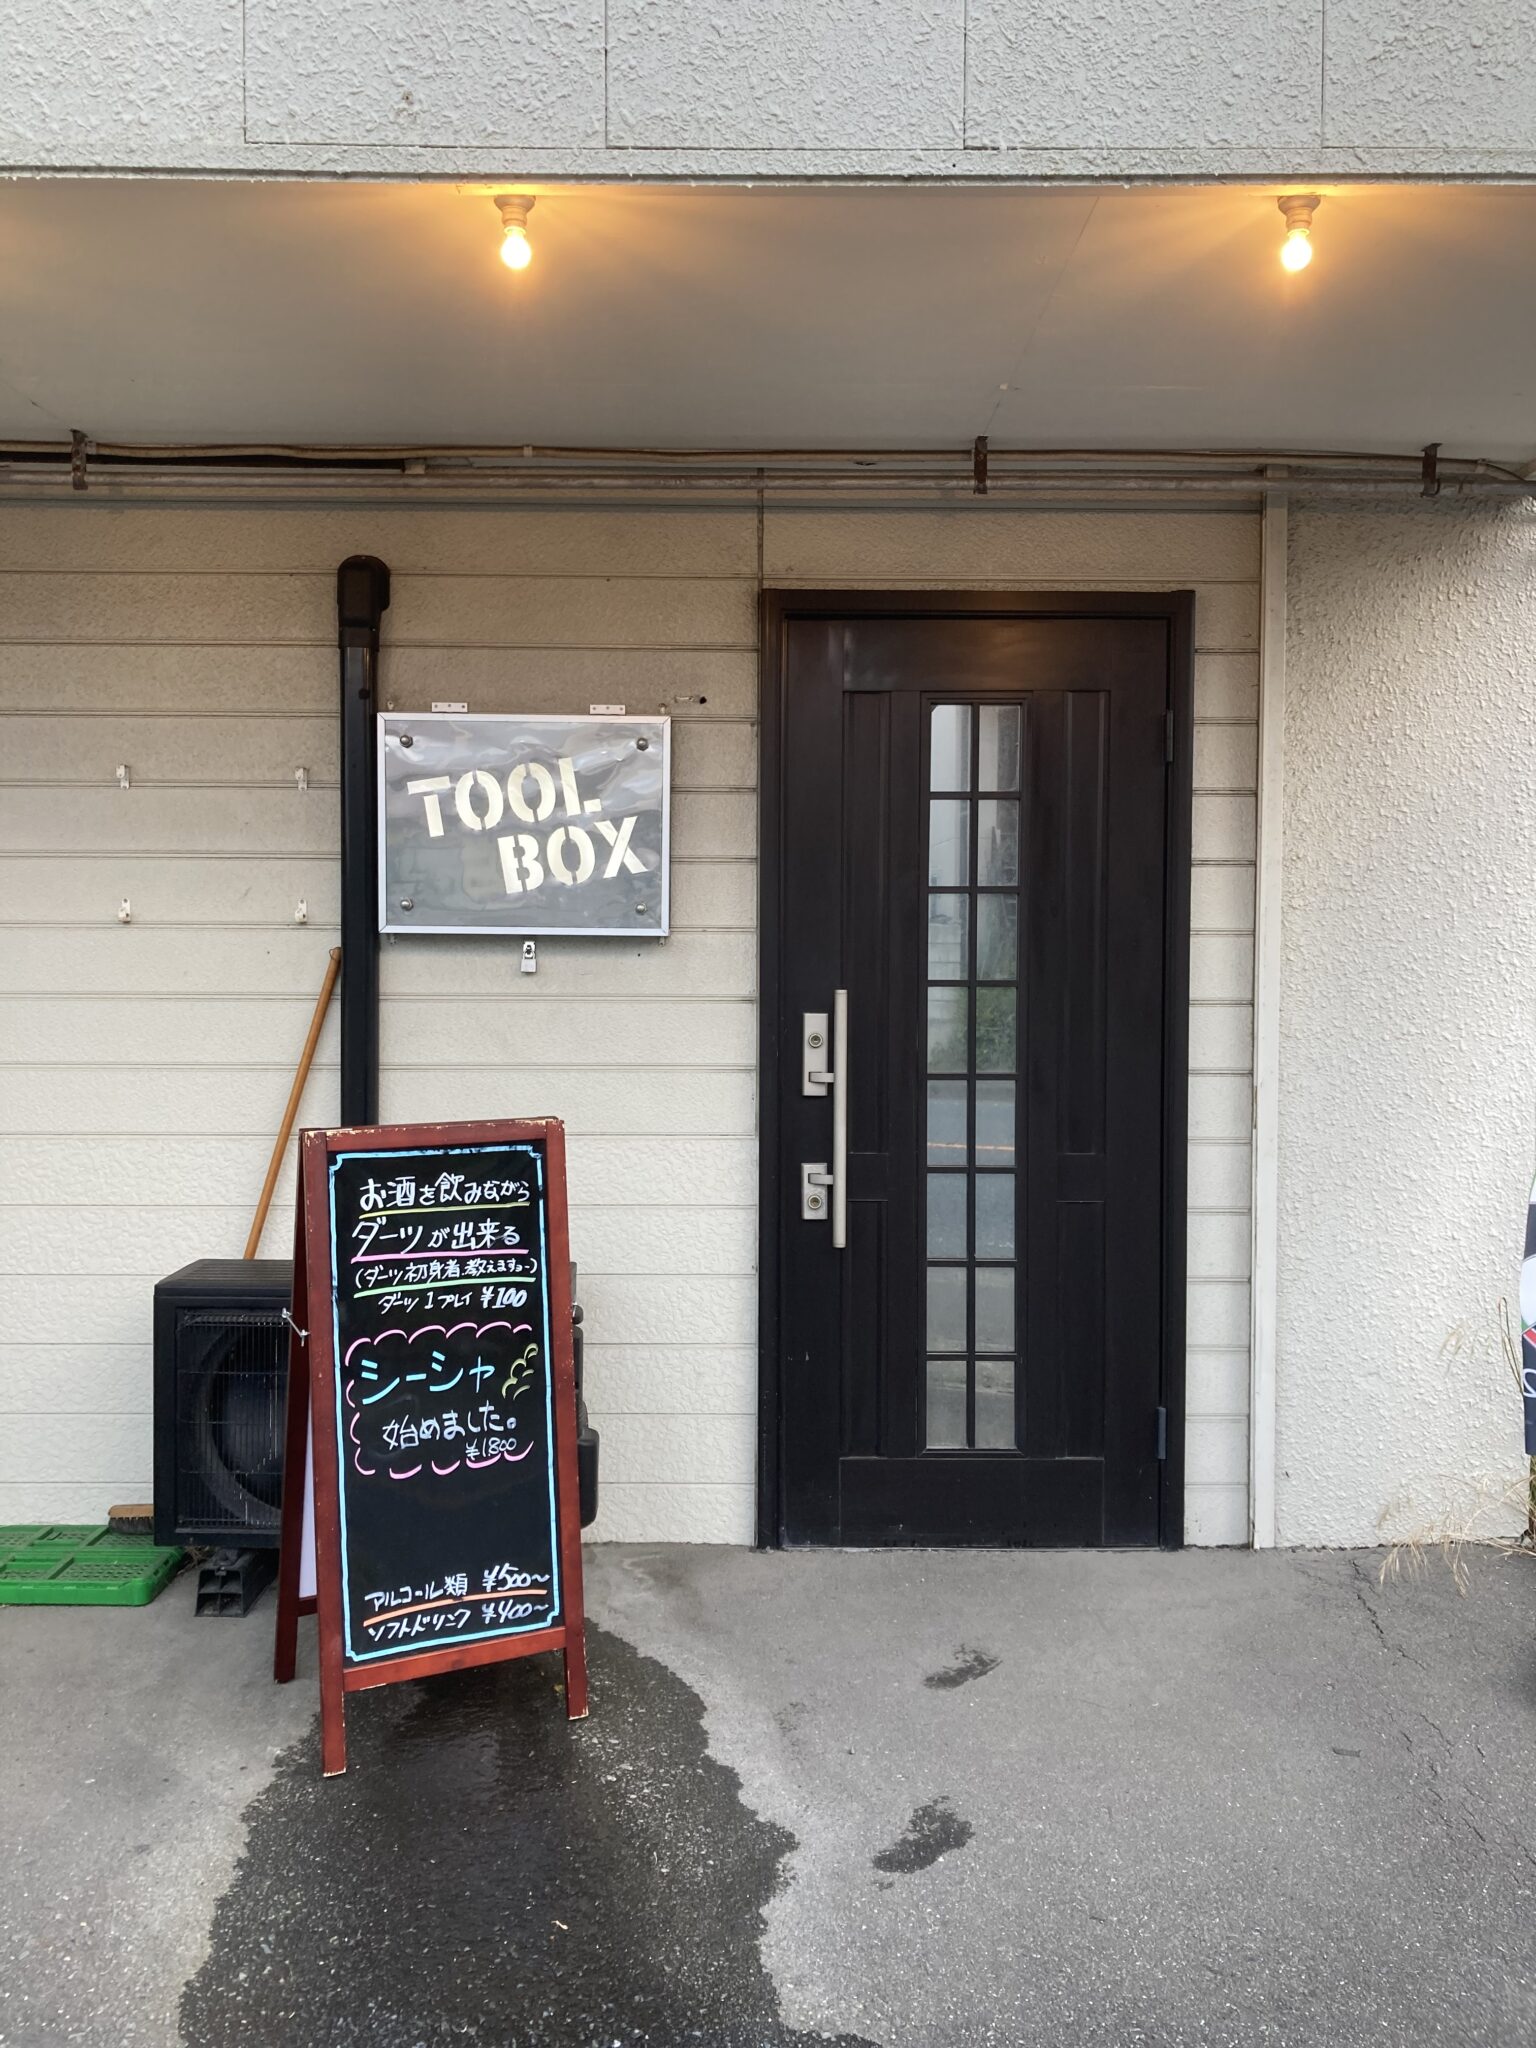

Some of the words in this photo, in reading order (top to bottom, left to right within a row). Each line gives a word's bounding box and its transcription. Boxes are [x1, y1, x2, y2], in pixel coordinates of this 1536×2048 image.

[407, 757, 602, 838] TOOL
[497, 815, 649, 895] BOX
[359, 1171, 531, 1211] お酒を飲みながら
[351, 1216, 521, 1258] ダーツが出来る
[480, 1285, 528, 1310] ¥100
[360, 1350, 496, 1405] シーシャ
[382, 1400, 517, 1450] 始めました。
[364, 1573, 469, 1612] アルコール類
[367, 1608, 471, 1642] ソフトドリンク
